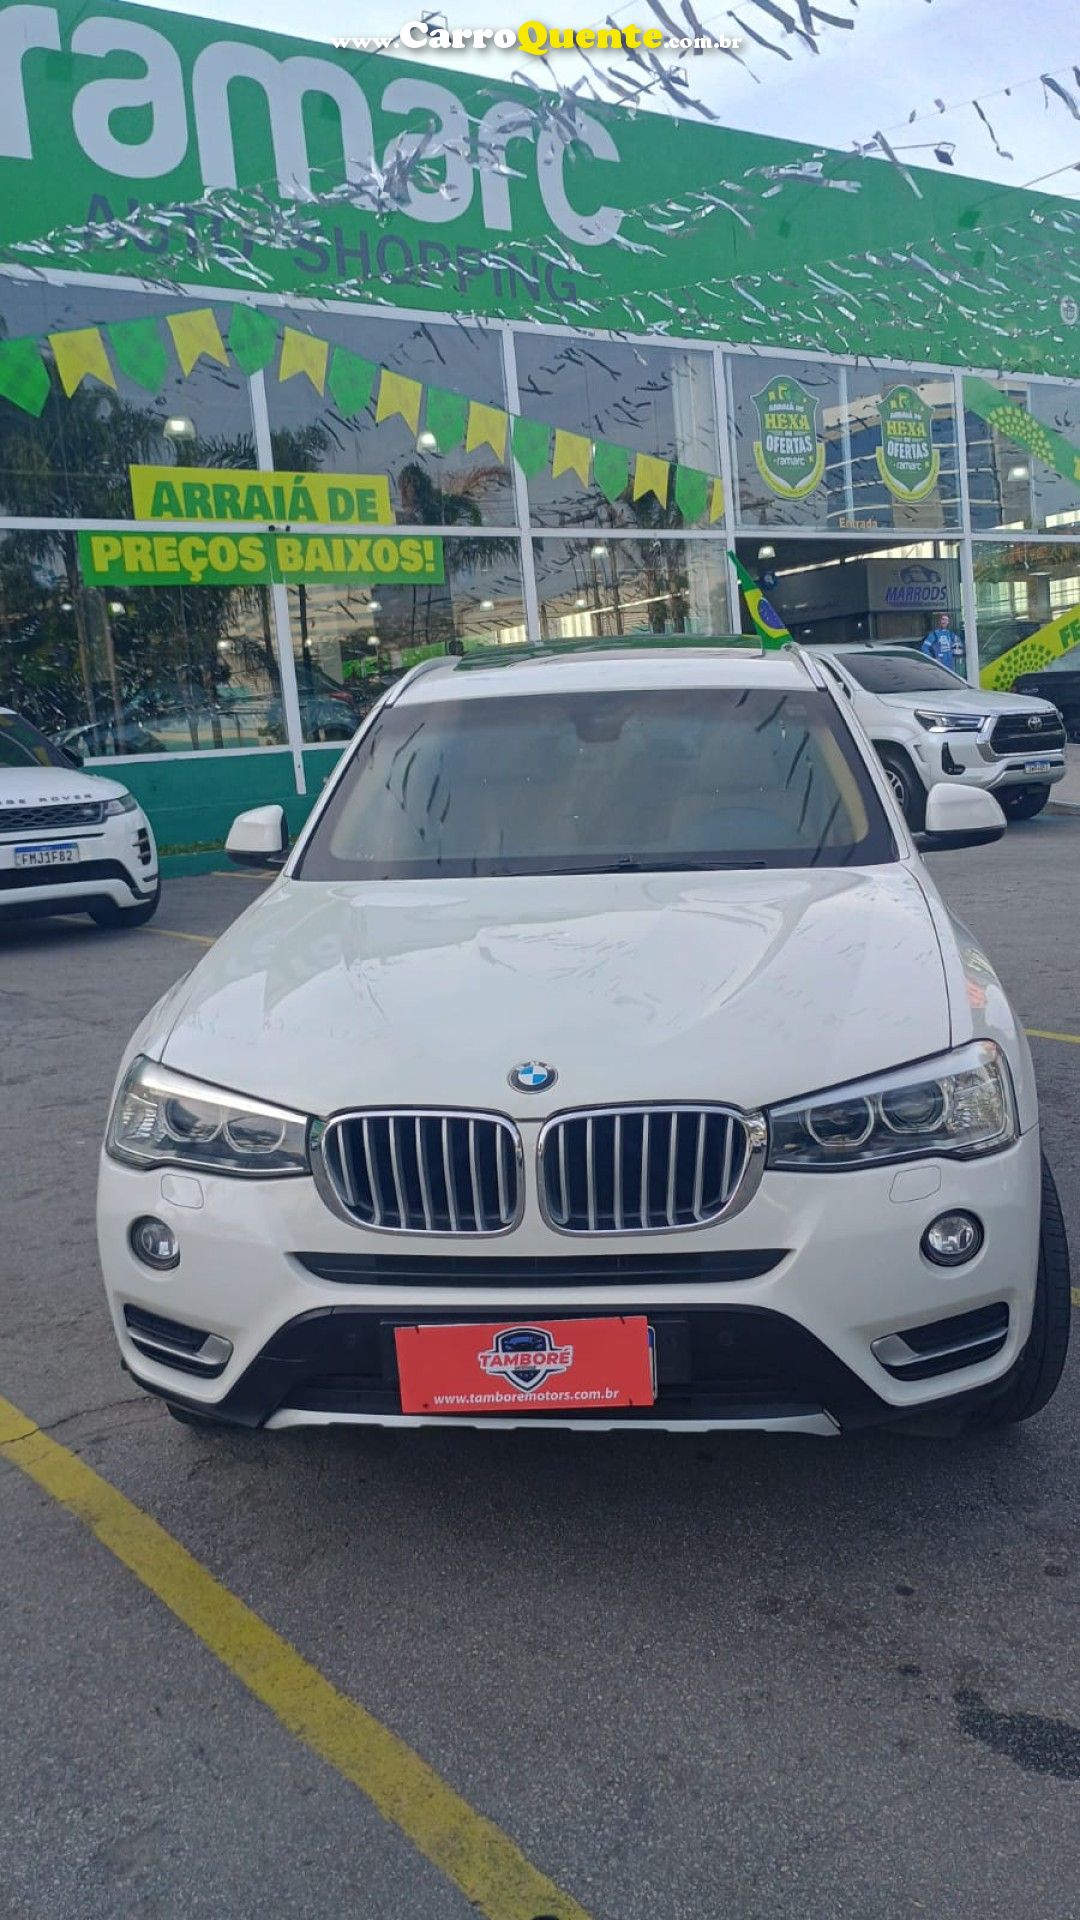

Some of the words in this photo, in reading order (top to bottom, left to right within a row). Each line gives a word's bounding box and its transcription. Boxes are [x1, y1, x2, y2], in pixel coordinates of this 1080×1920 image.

[0, 4, 620, 246] ramarc
[291, 227, 579, 303] SHOPPING
[764, 413, 810, 430] HEXA
[886, 421, 928, 436] HEXA
[766, 434, 813, 454] OFERTAS
[887, 440, 929, 460] OFERTAS
[150, 475, 318, 522] ARRAIÁ
[327, 487, 379, 522] DE
[839, 518, 877, 528] Entrada
[90, 535, 267, 582] PREÇOS
[275, 537, 435, 574] BAIXOS!
[885, 585, 947, 602] MARRODS
[39, 794, 93, 802] ROVER
[480, 1347, 571, 1367] TAMBORÉ
[434, 1388, 619, 1405] www.tamboremotors.com.br
